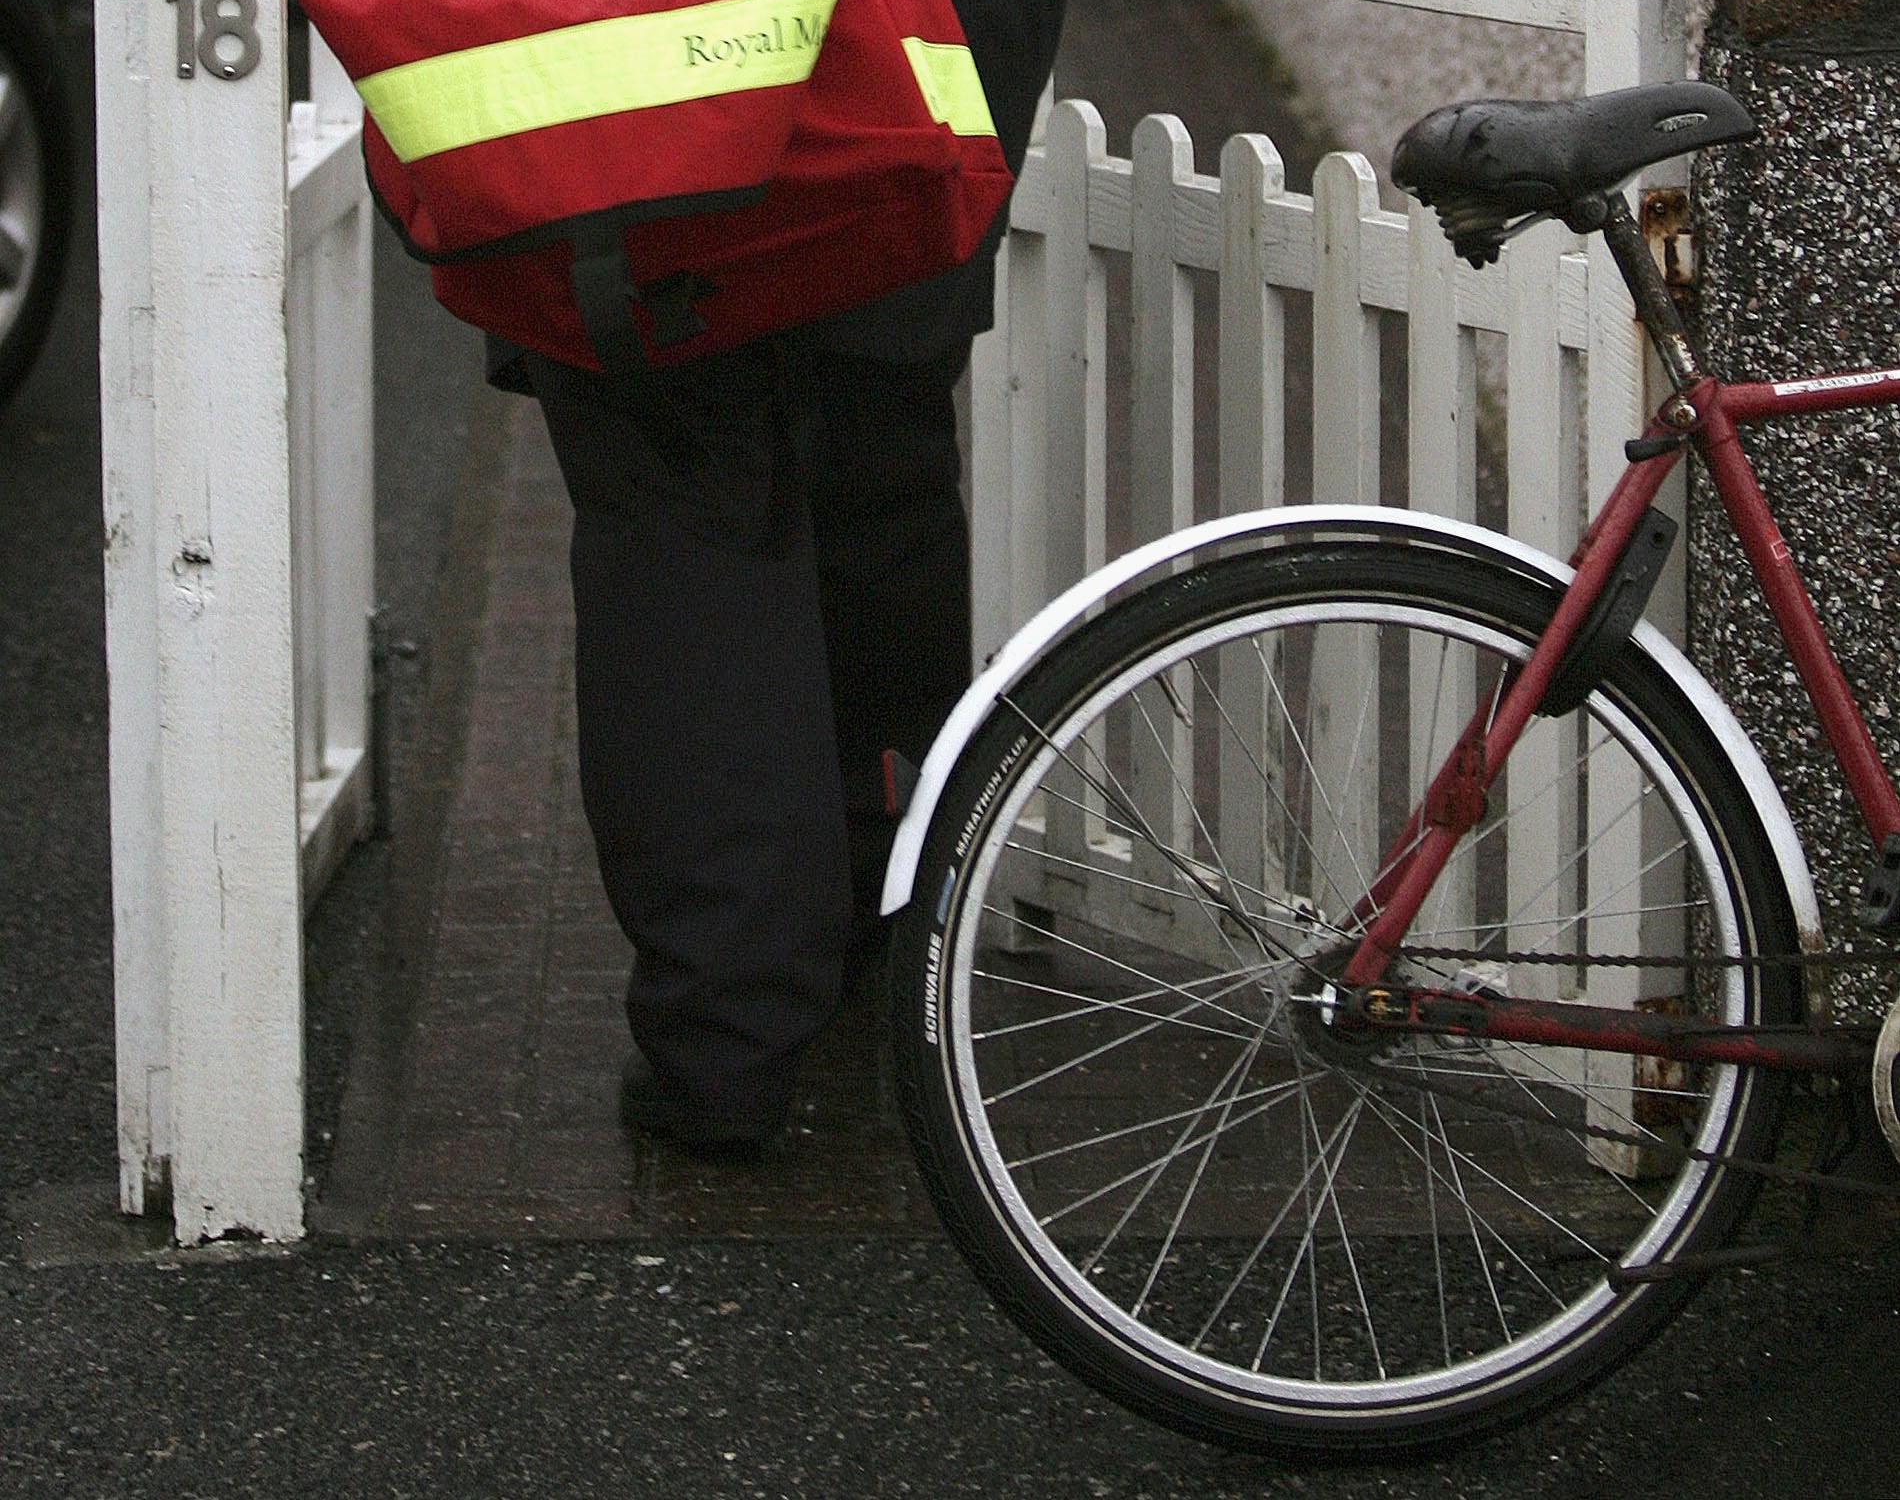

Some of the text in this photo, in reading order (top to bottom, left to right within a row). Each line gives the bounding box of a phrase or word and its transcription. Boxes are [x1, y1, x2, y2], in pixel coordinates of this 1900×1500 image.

[682, 16, 786, 69] Royal
[955, 771, 1003, 858] MARATHON
[924, 931, 943, 1046] SCHWALBE
